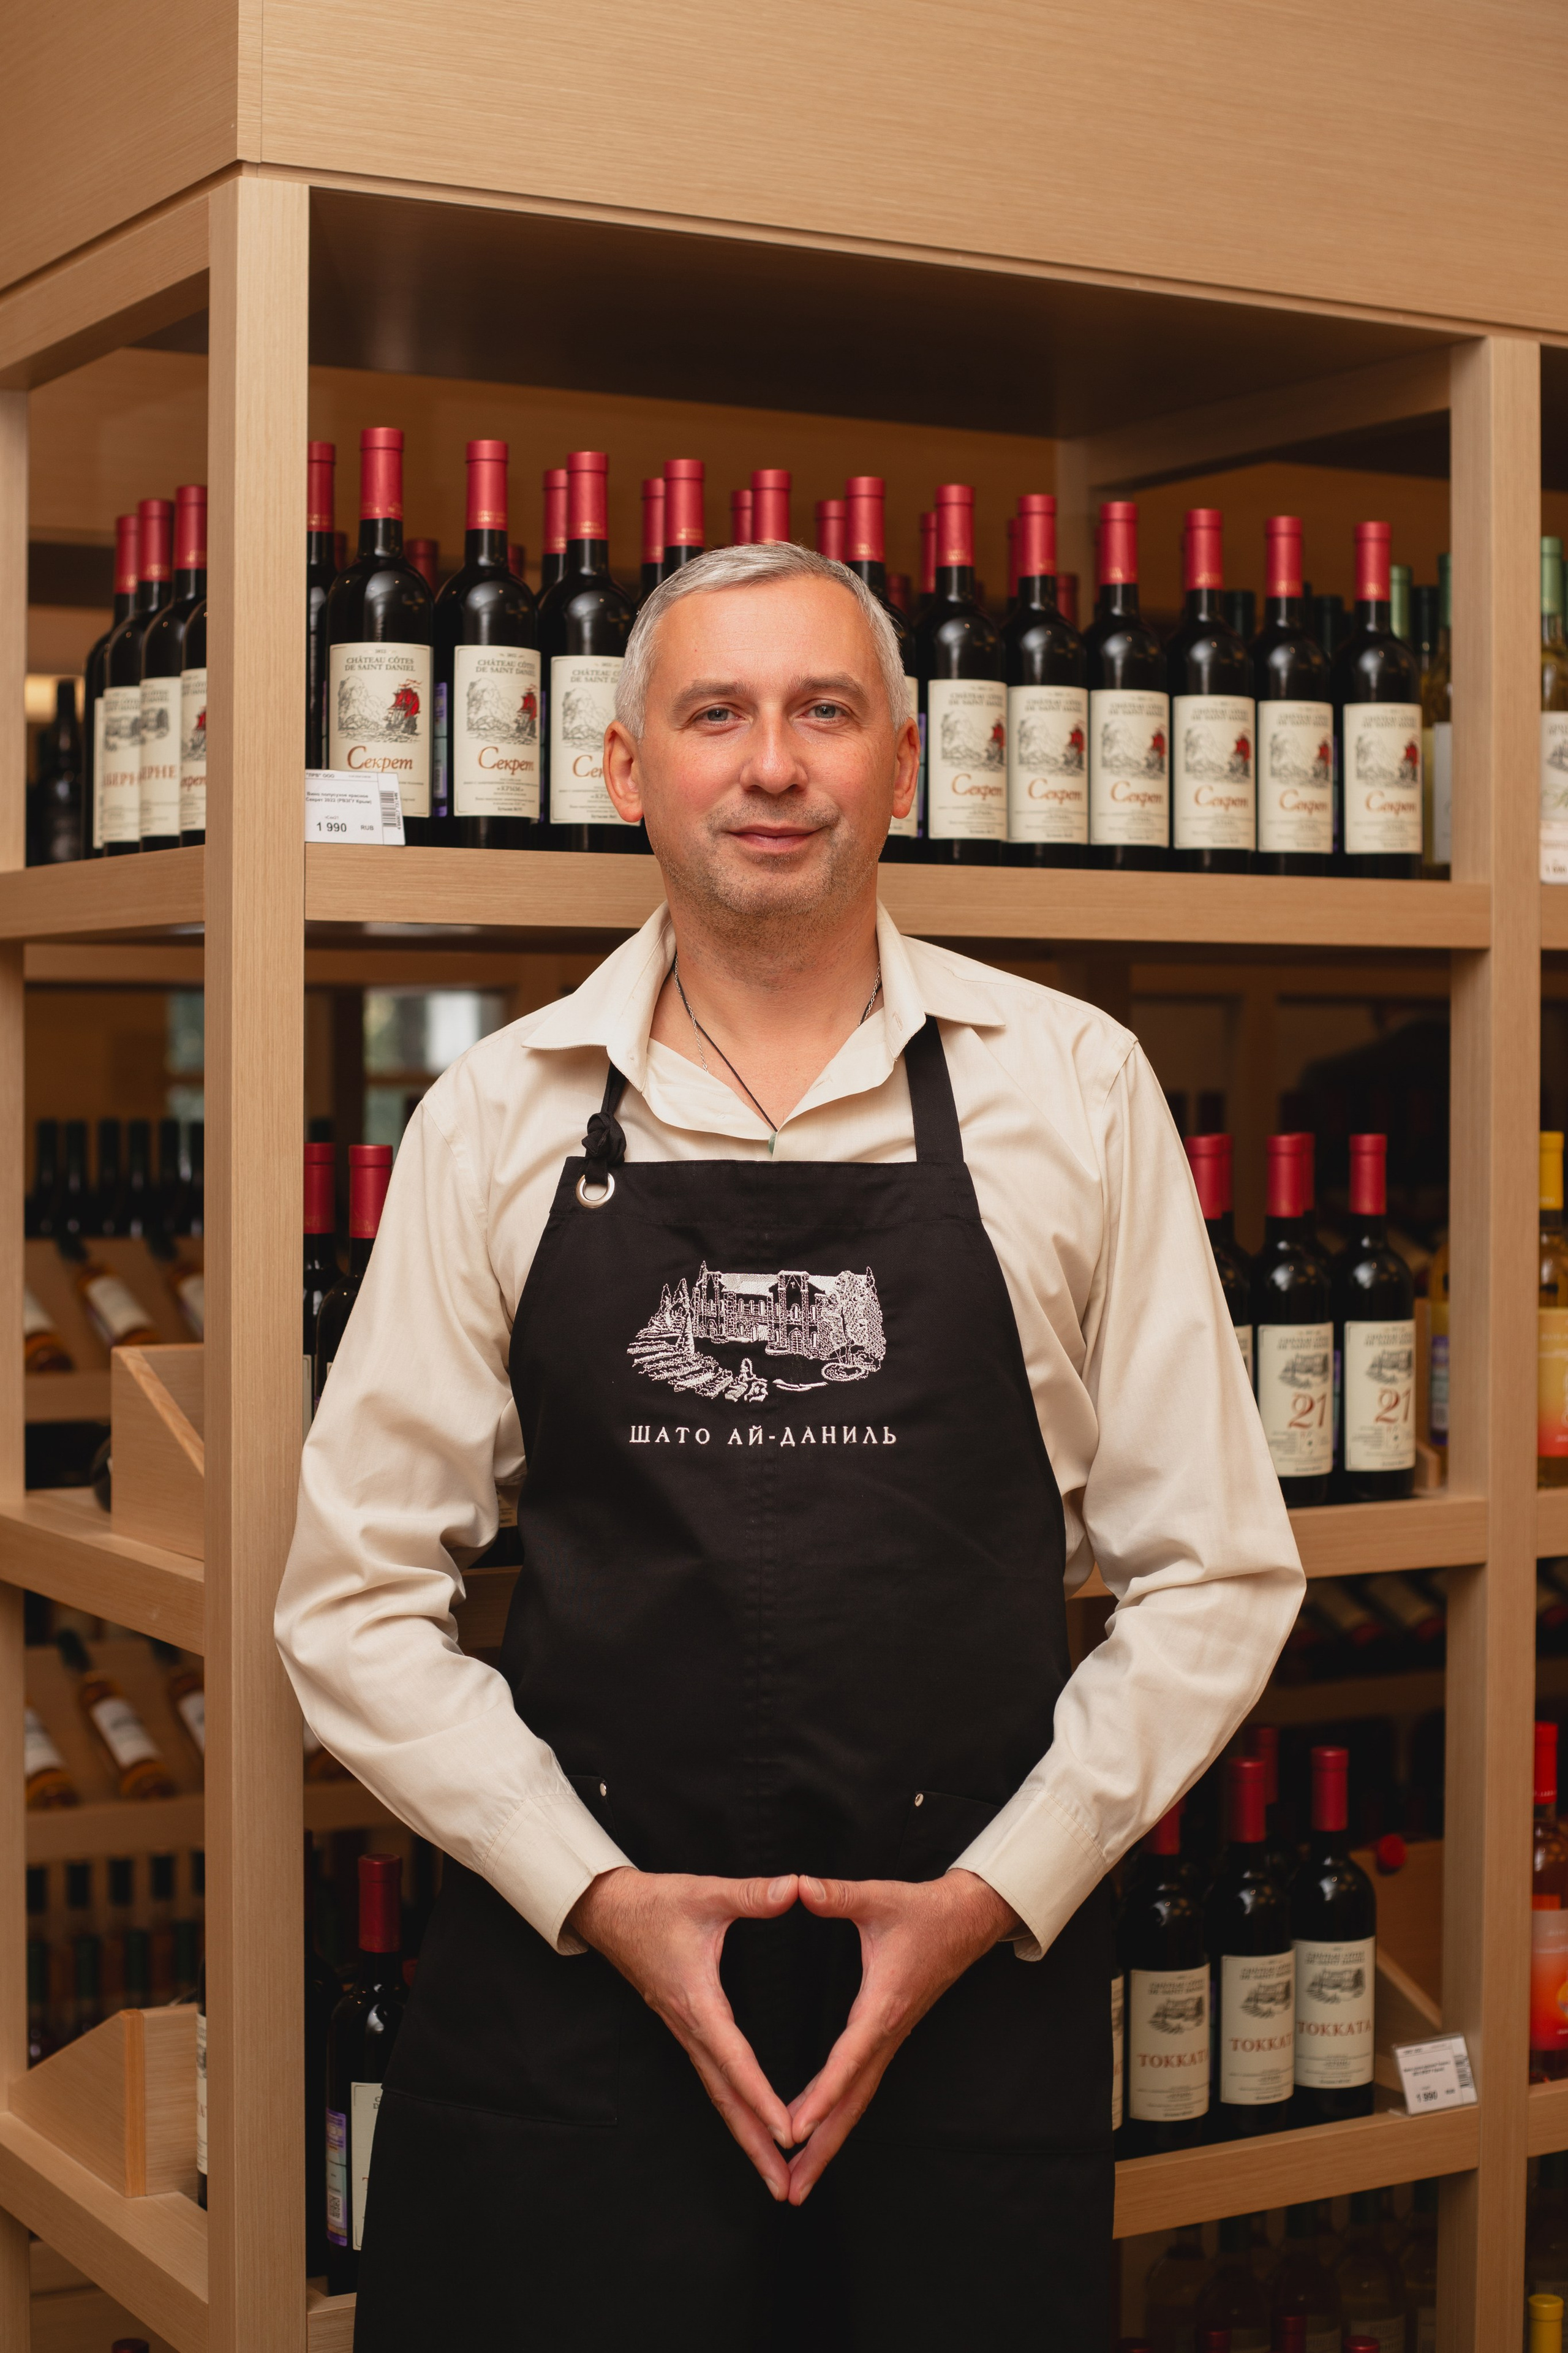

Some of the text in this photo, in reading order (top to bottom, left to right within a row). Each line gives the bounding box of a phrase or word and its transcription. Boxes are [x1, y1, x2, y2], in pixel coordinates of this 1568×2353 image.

[347, 746, 413, 772] Секрет
[478, 746, 535, 776] Секрет
[326, 822, 347, 832] 990
[1288, 1392, 1327, 1429] 21
[1374, 1388, 1411, 1424] 21
[629, 1424, 897, 1448] ШАТО АЙ-ДАНИЛЬ
[1229, 2033, 1292, 2052] ТОККАТ
